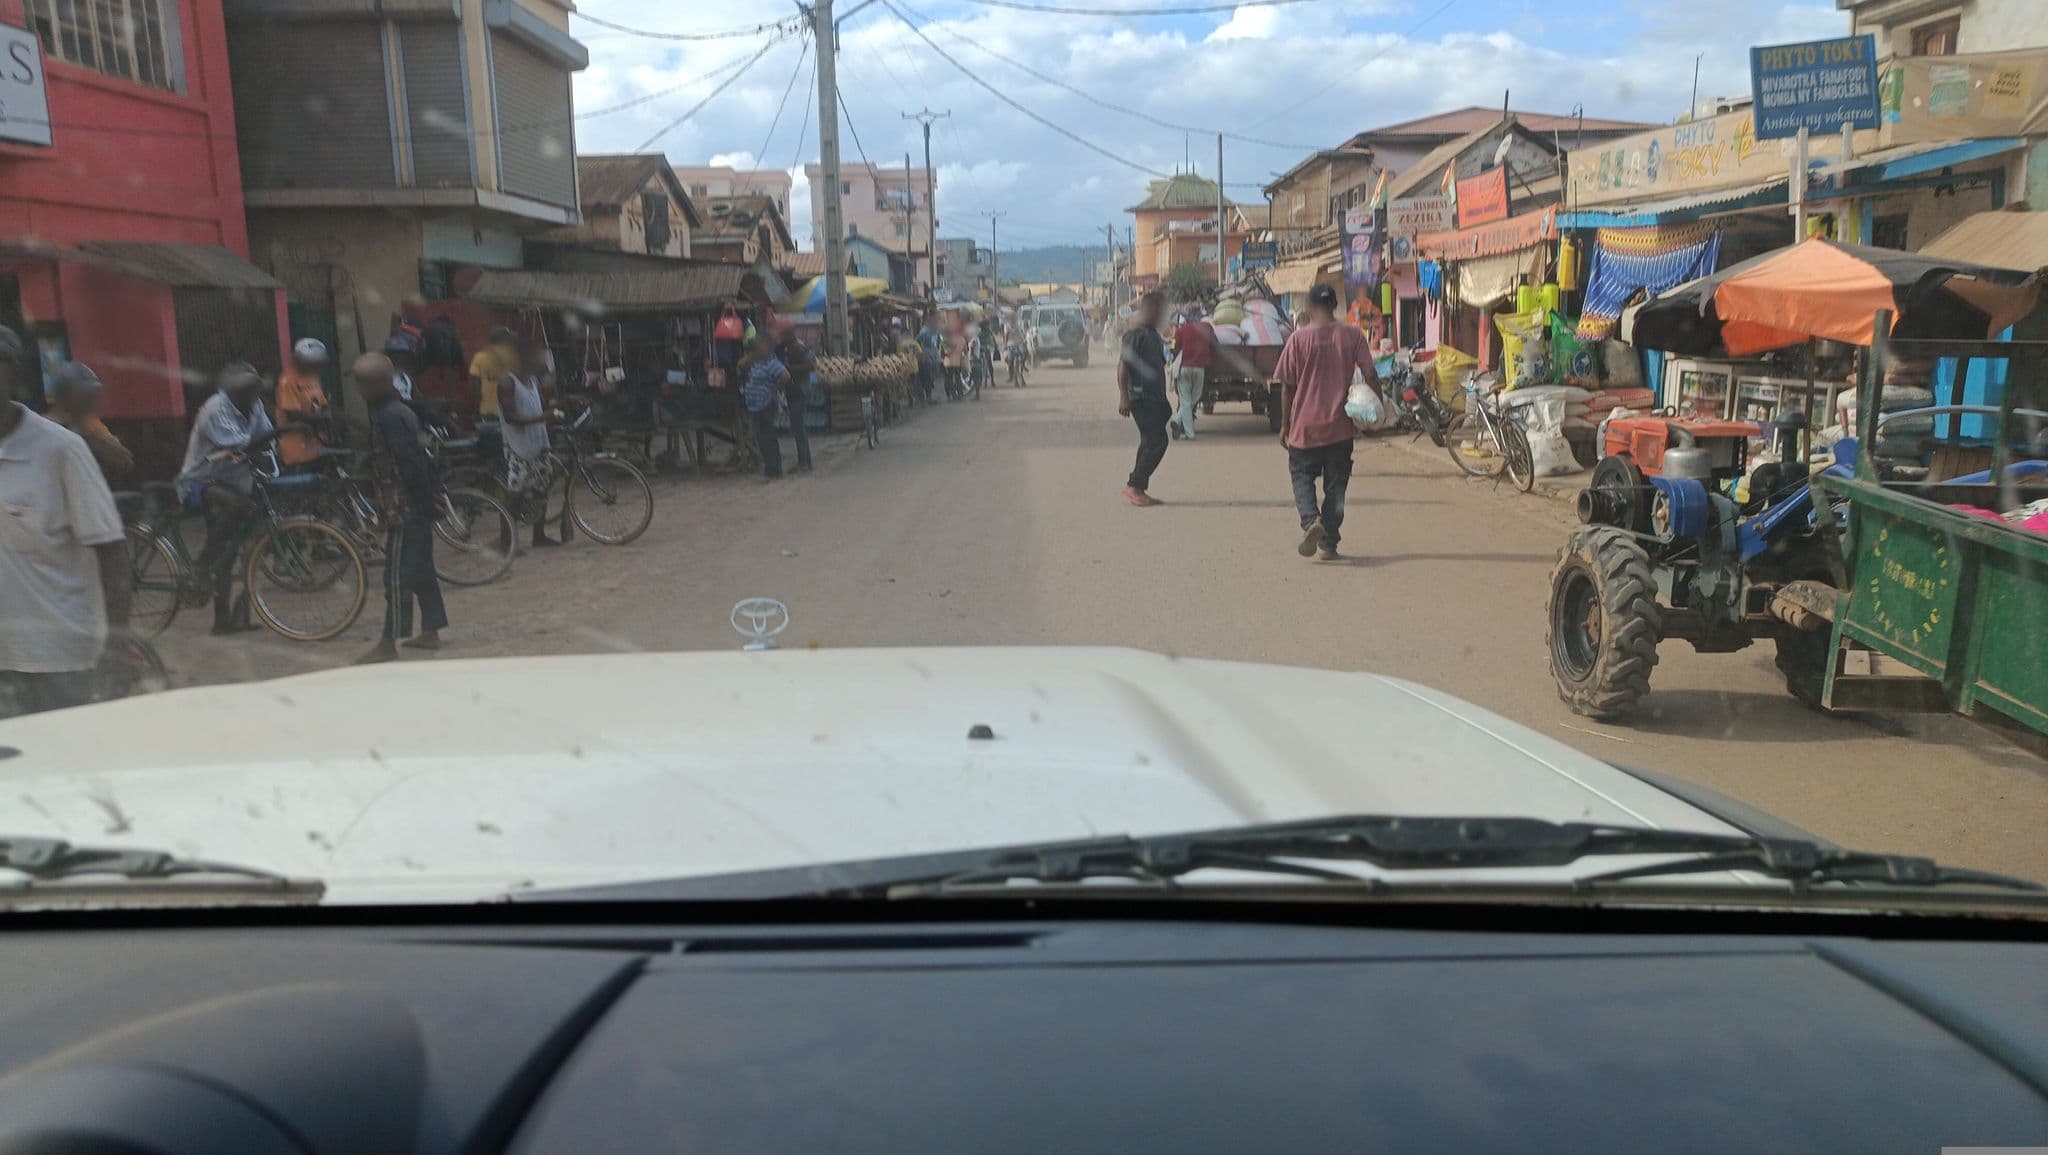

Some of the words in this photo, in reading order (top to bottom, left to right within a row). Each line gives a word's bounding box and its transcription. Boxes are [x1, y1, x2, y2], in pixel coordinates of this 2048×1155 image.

[0, 41, 34, 85] S
[1762, 46, 1816, 71] PHYTO
[1822, 40, 1865, 64] TOKY
[1762, 88, 1797, 109] MOMBA
[1798, 87, 1810, 104] NY
[1813, 81, 1869, 102] FAMBOLENA
[1674, 120, 1717, 147] PHYTO
[1665, 140, 1726, 182] TOKY
